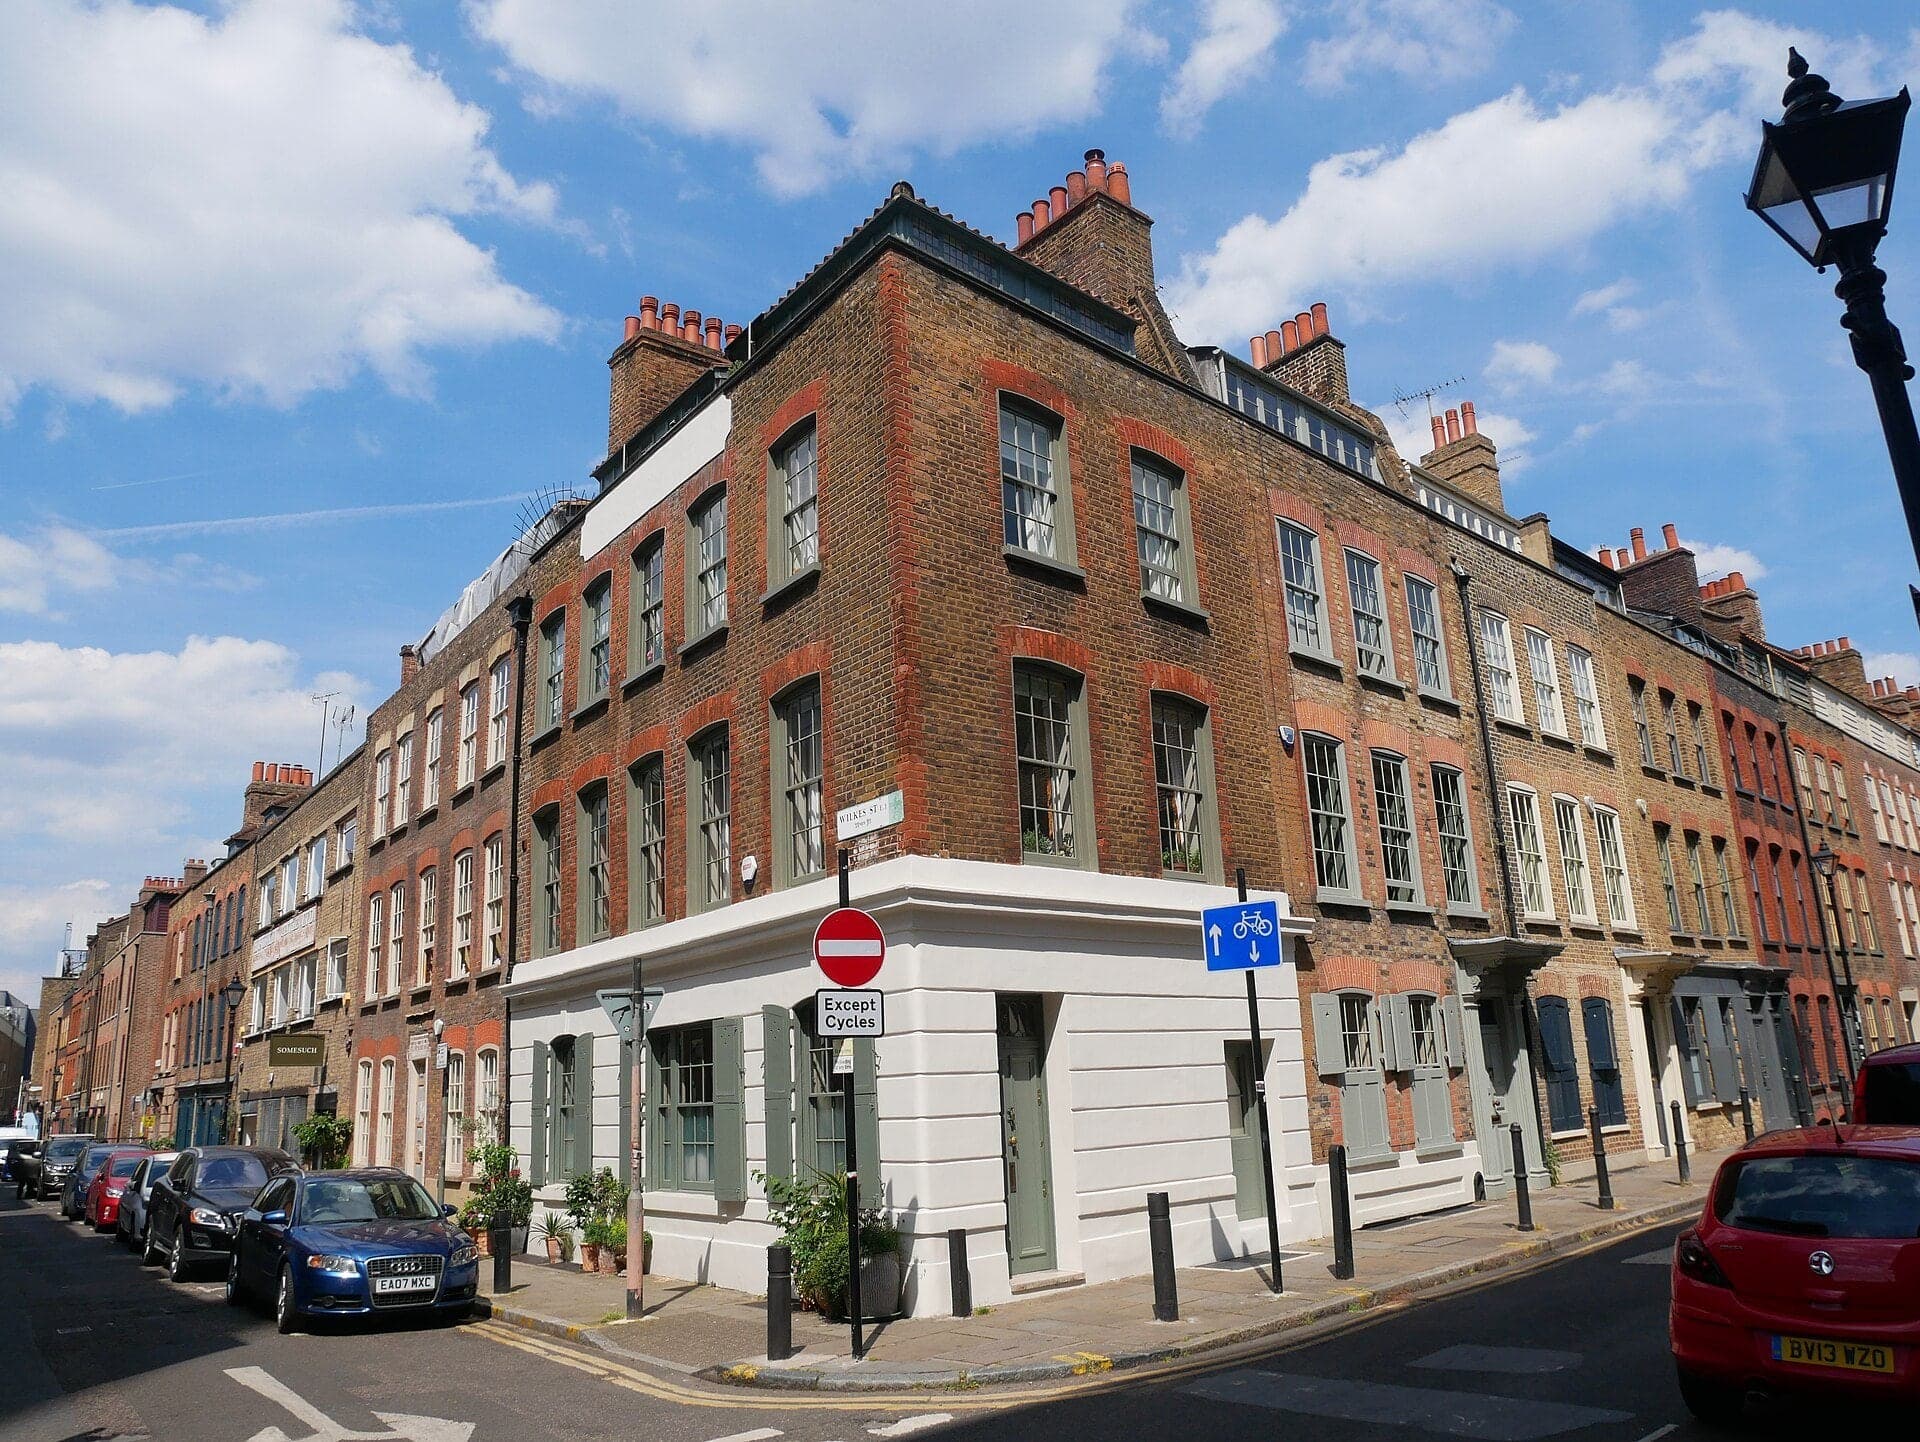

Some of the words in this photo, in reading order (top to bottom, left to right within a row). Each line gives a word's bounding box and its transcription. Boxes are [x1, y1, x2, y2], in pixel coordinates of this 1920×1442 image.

[839, 809, 867, 823] WILKES
[870, 804, 877, 815] ST
[824, 998, 876, 1013] Except
[825, 1015, 875, 1030] Cycles
[276, 1046, 317, 1054] SOMESUCH
[380, 1278, 409, 1290] EA07
[411, 1277, 431, 1288] MXC
[1789, 1339, 1836, 1363] BV13
[1844, 1345, 1886, 1369] WZO
